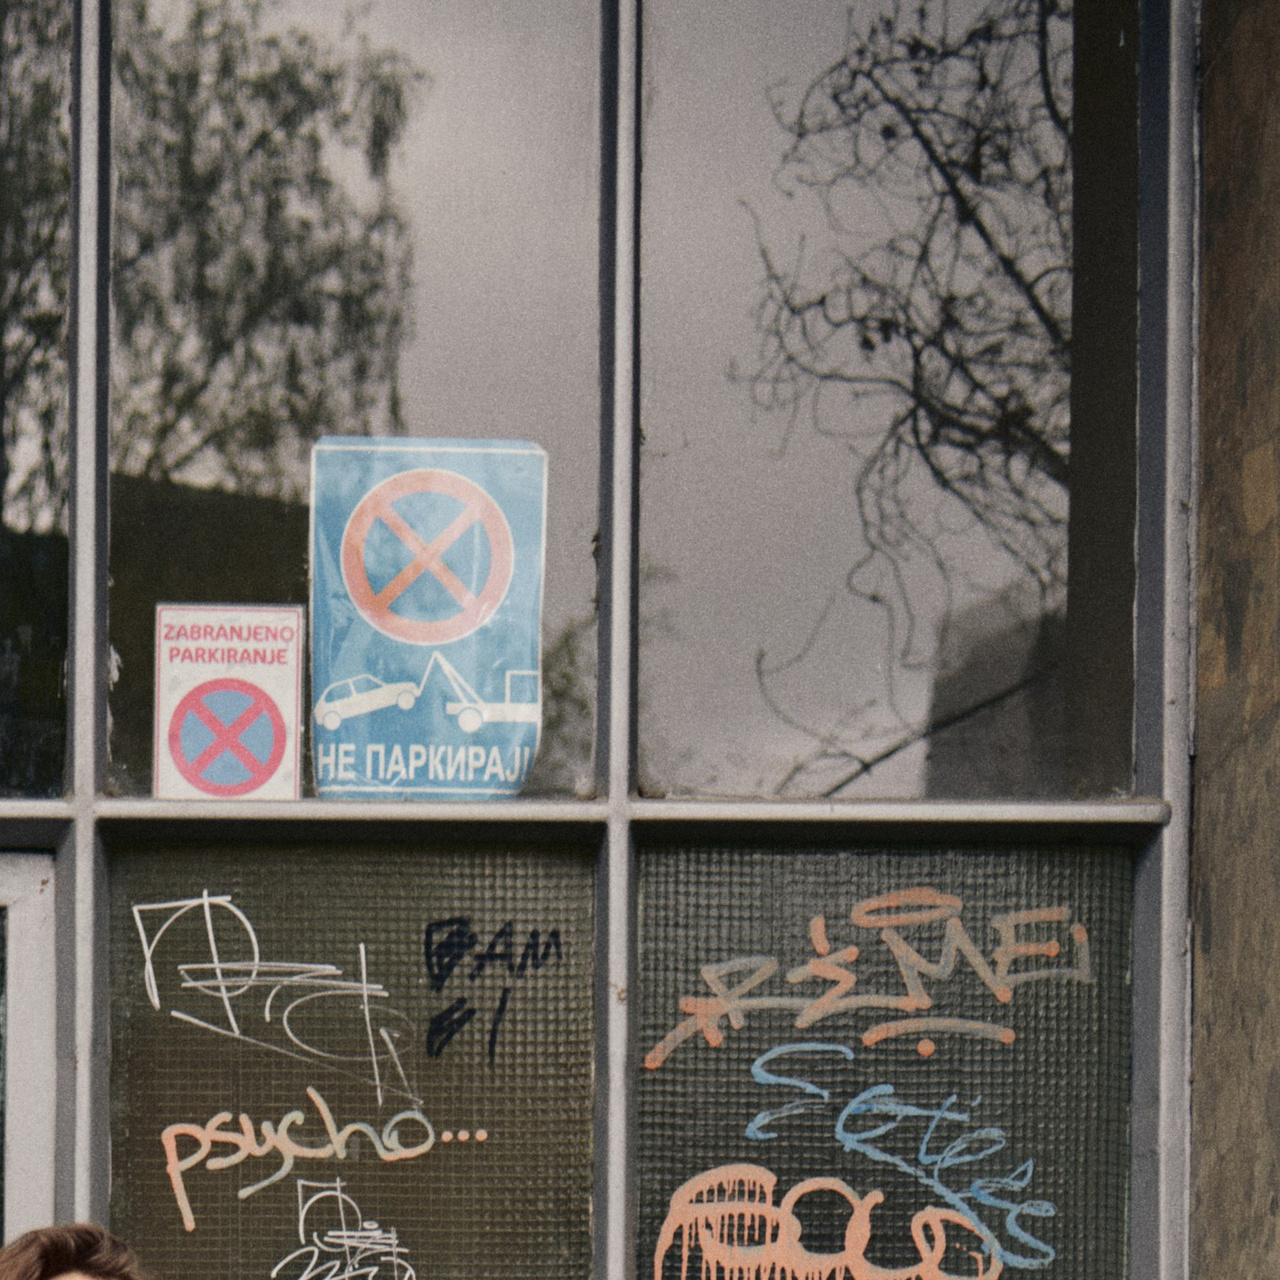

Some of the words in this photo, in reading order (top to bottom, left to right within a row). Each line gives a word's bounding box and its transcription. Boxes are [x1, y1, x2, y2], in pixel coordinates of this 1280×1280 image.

[163, 622, 295, 645] ZABRANJENO
[168, 646, 289, 666] PARKIRANJE
[317, 742, 357, 781] НЕ
